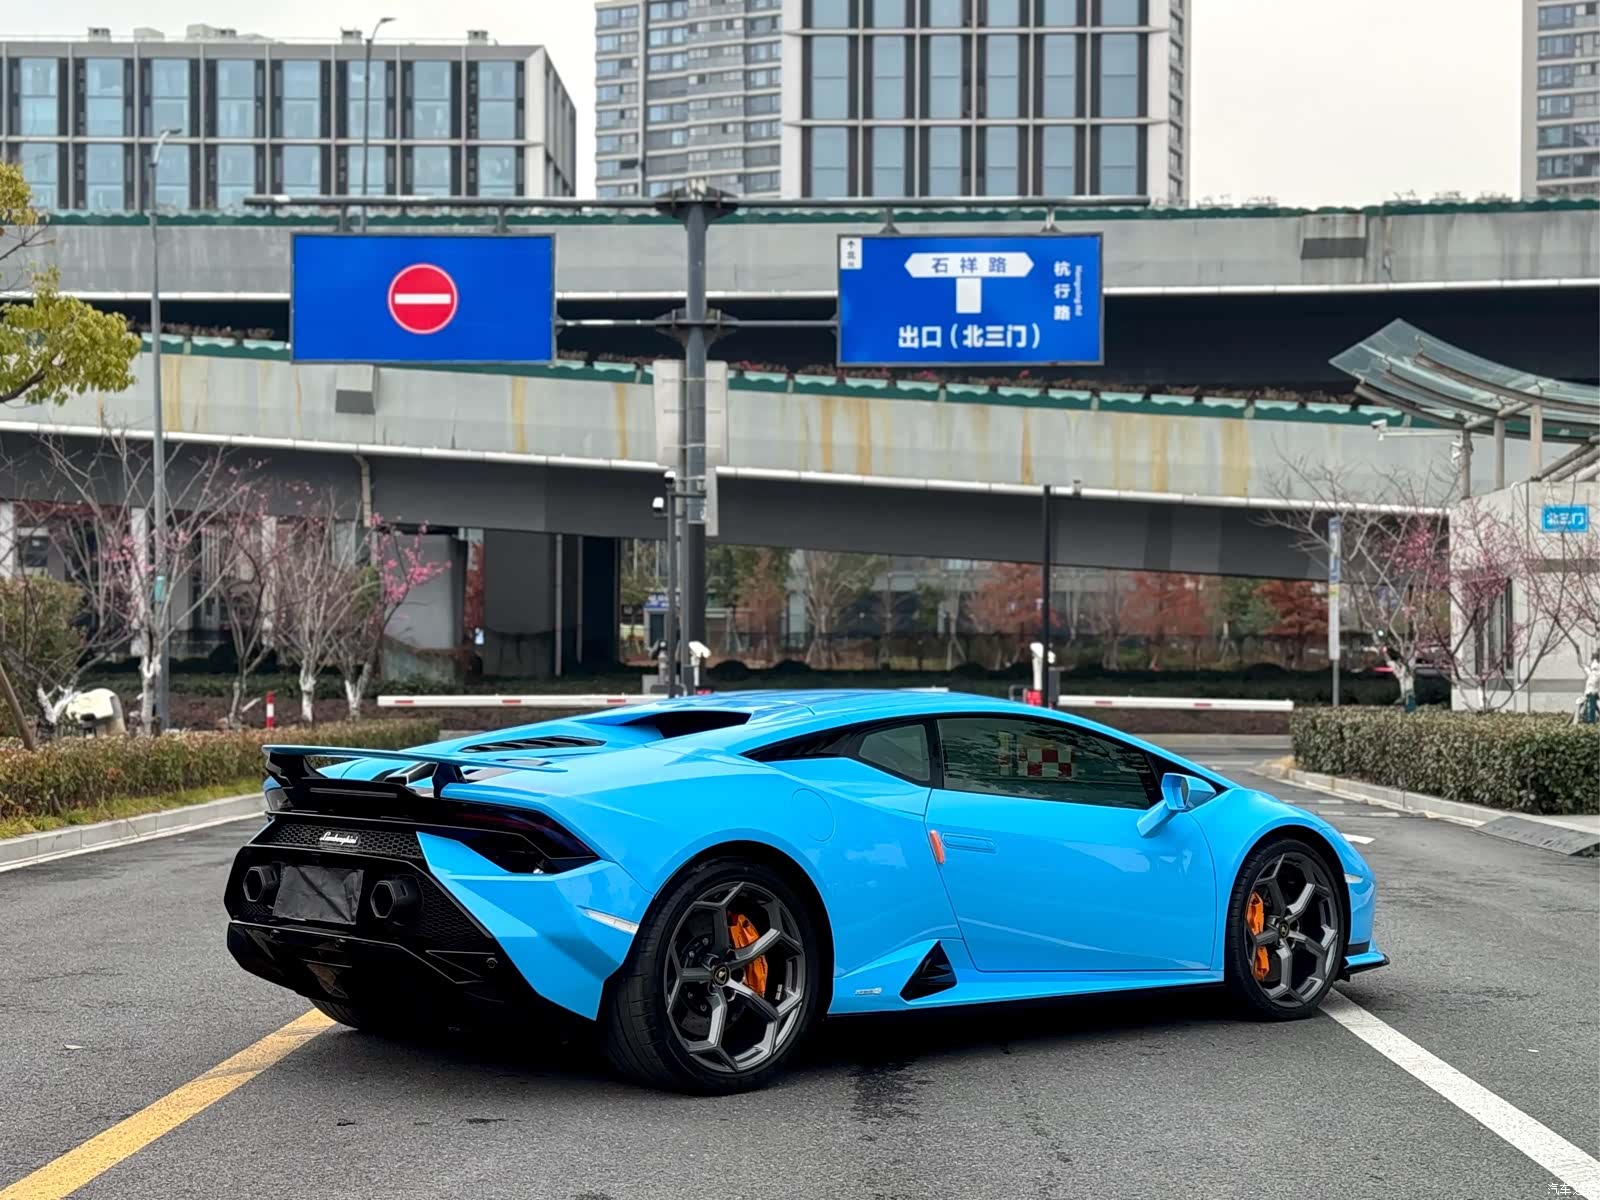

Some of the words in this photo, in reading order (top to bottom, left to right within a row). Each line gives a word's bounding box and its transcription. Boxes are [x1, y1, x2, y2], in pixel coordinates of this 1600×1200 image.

[931, 257, 1007, 273] 石祥路
[1054, 260, 1071, 321] 杭行路
